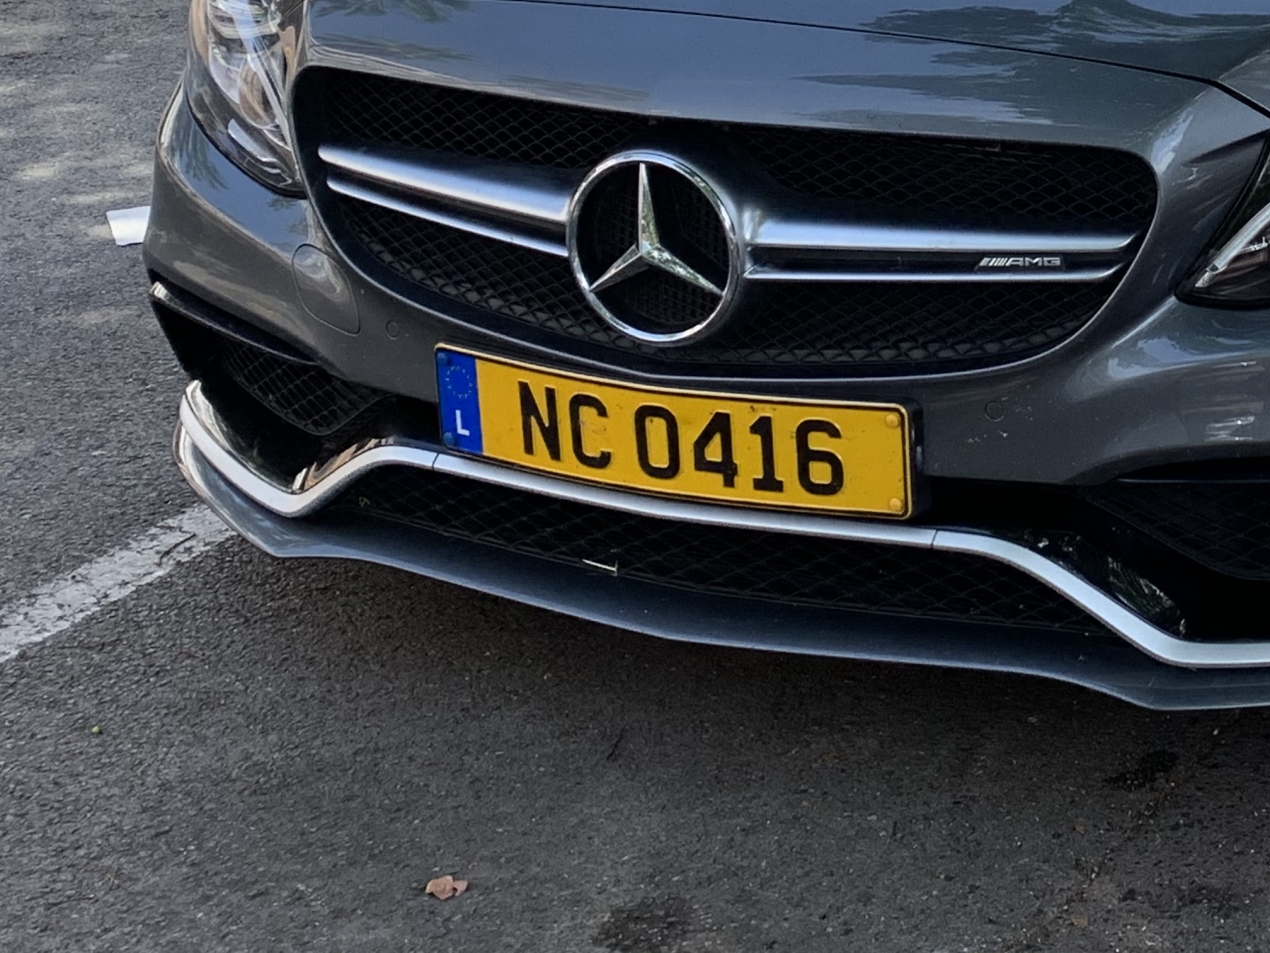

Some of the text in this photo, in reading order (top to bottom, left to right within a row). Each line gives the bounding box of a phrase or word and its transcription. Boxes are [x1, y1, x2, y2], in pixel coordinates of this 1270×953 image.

[455, 409, 470, 437] L
[518, 380, 844, 496] NC 0416
